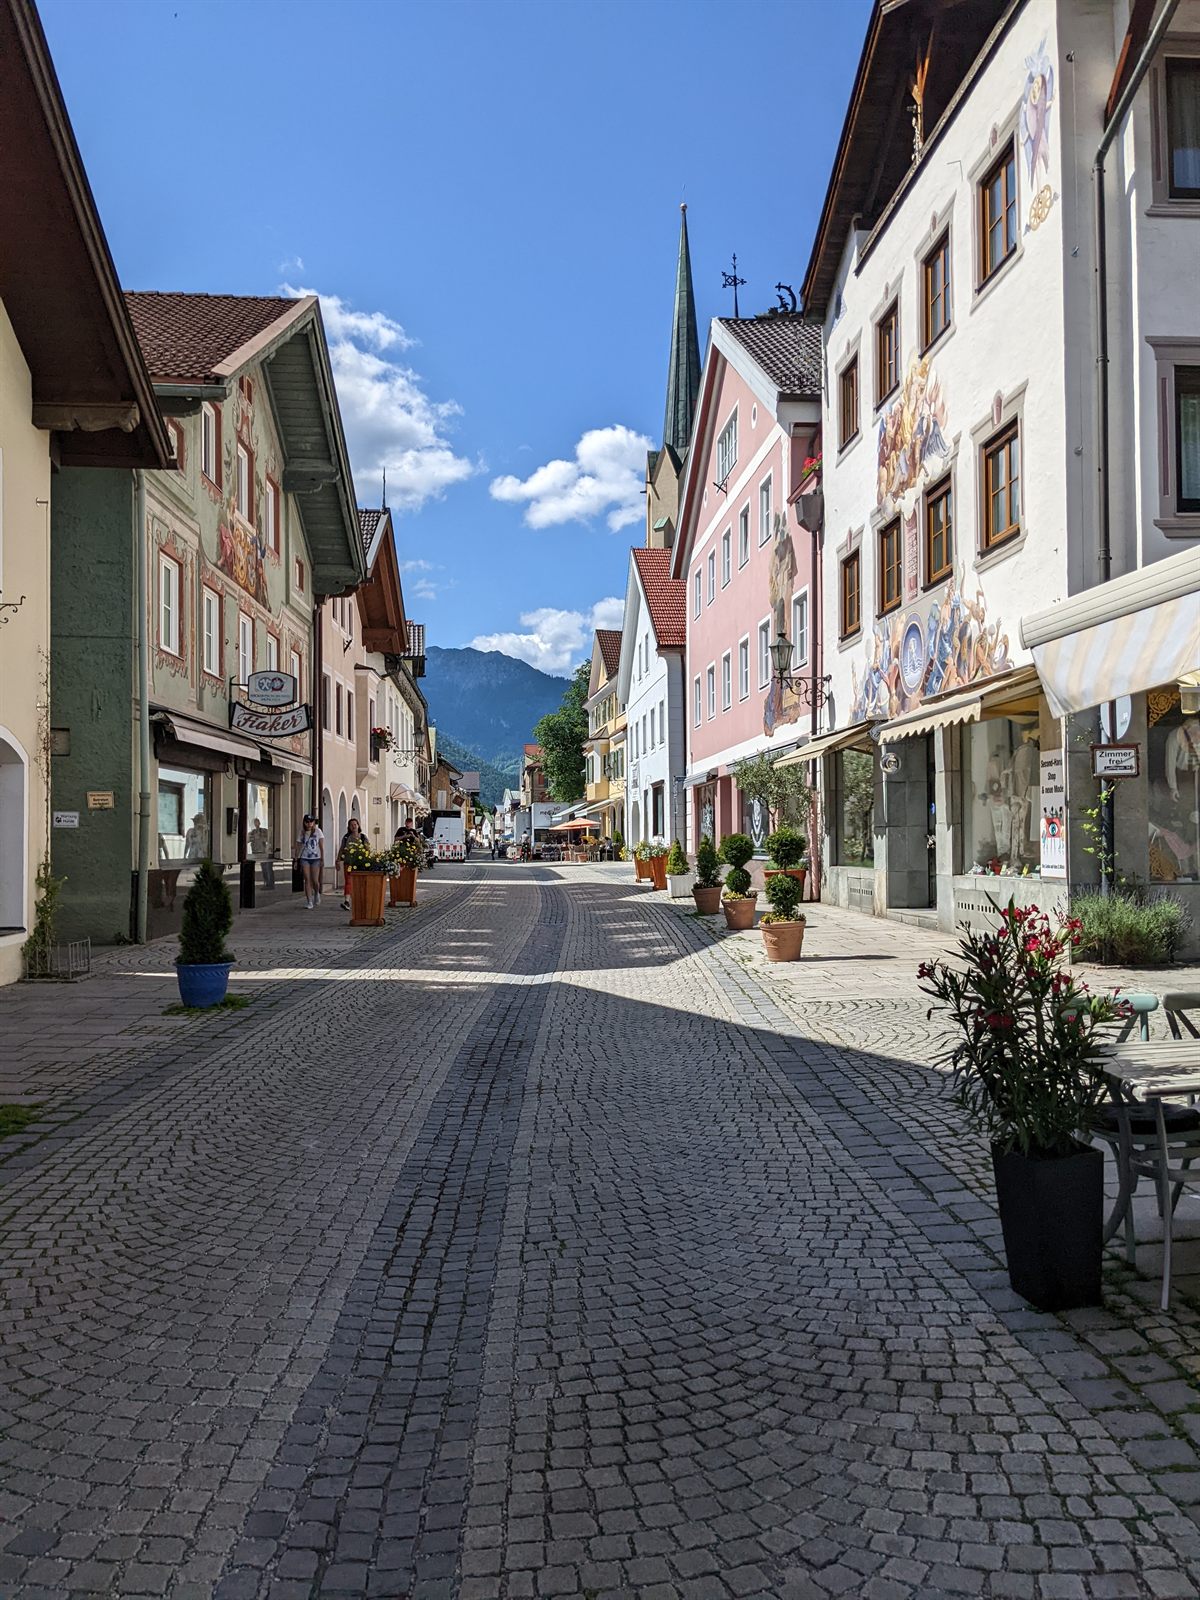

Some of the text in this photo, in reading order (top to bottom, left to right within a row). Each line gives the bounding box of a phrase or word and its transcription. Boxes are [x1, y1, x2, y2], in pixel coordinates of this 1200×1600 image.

[237, 711, 302, 731] Fiaker
[1047, 772, 1056, 782] Shop
[1054, 784, 1064, 793] Mode
